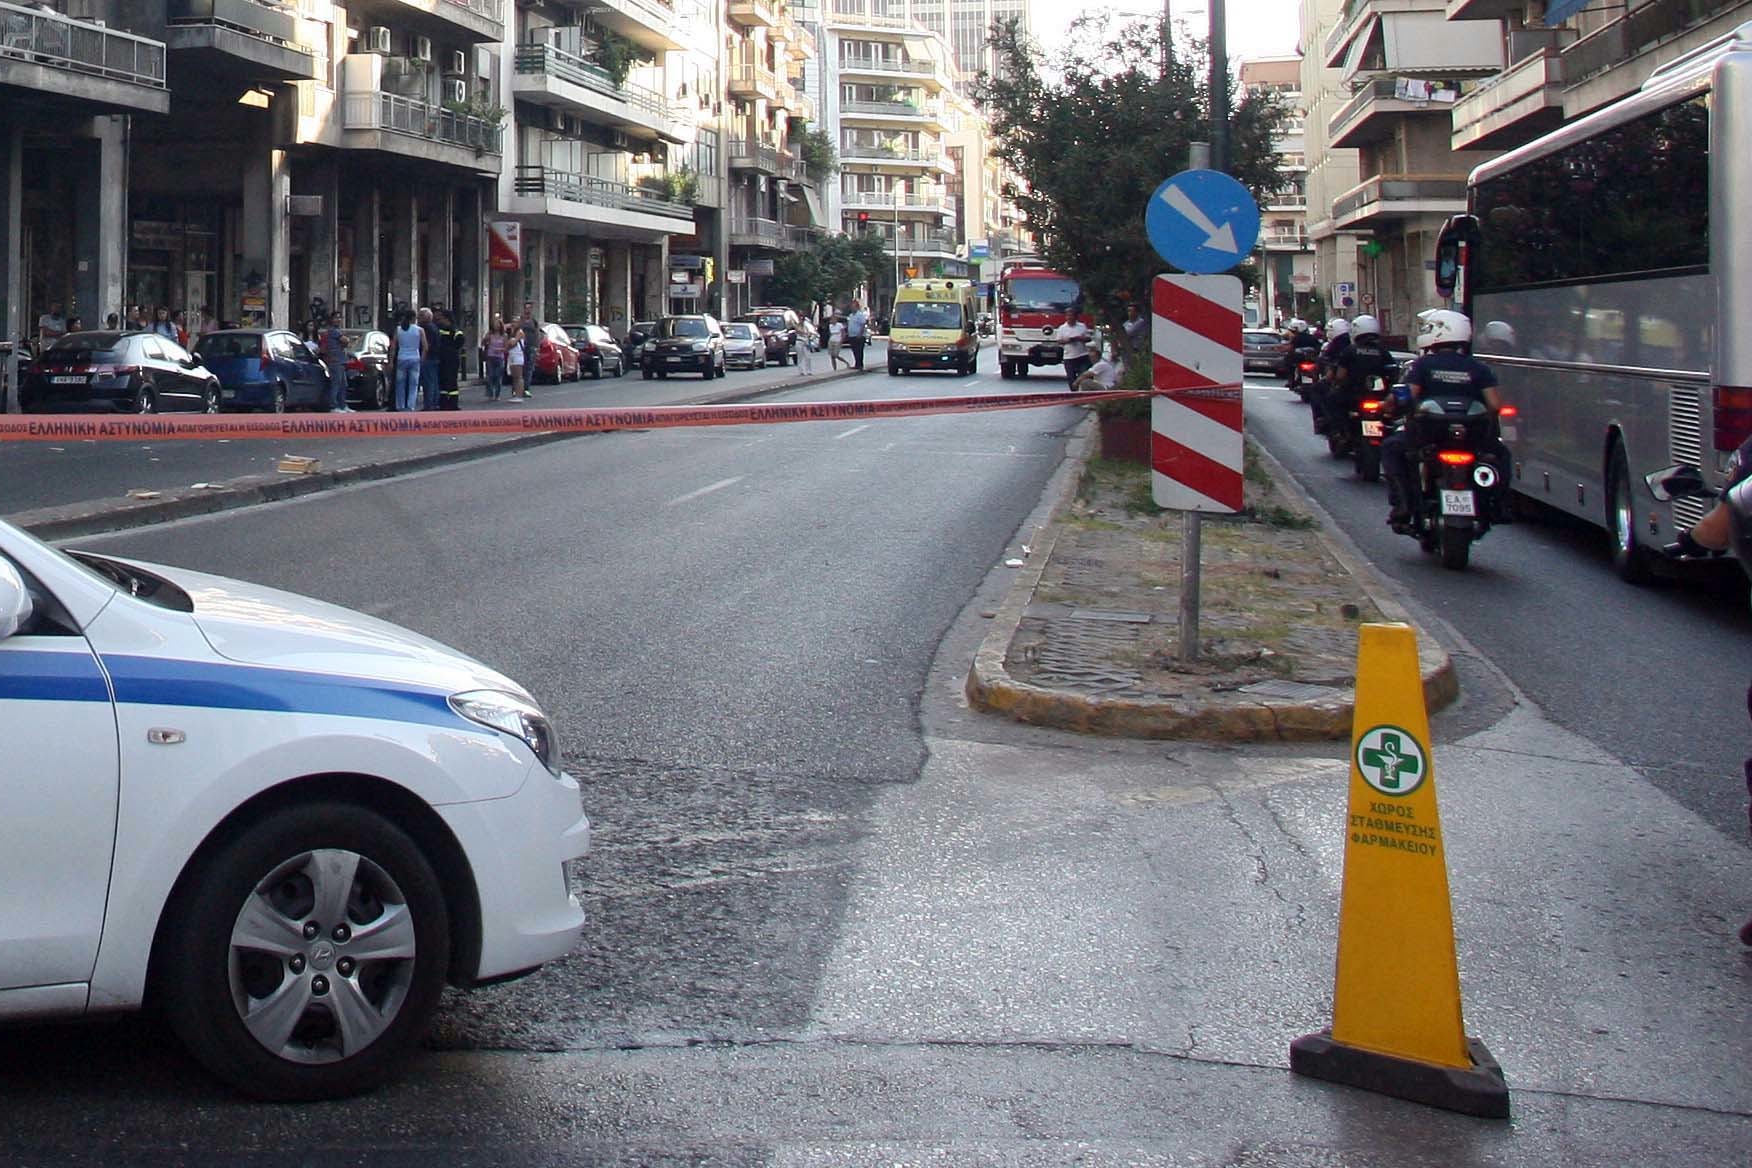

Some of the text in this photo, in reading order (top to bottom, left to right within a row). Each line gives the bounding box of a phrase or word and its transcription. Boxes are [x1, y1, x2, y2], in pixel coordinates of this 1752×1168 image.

[29, 421, 97, 435] ΕΛΛΗΝΙΚΗ
[100, 421, 177, 435] ΑΣΤΥΝΟΜΙΑ
[282, 420, 345, 433] ΕΛΛΗΝΙΚΗ
[349, 419, 422, 432] ΑΣΤΥΝΟΜΙΑ
[522, 415, 583, 429] ΕΛΛΗΝΙΚΗ
[586, 412, 655, 427] ΑΣΤΥΝΟΜΙΑ
[750, 406, 808, 421] ΕΛΛΗΝΙΚΗ
[810, 402, 876, 418] ΑΣΤΥΝΟΜΙΑ
[1369, 801, 1415, 819] ΧΩΡΟΣ
[1351, 815, 1436, 840] ΣΤΑΘΜΕΥΣΗΣ
[1351, 832, 1437, 856] ΦΑΡΜΑΚΕΙΟΥ
